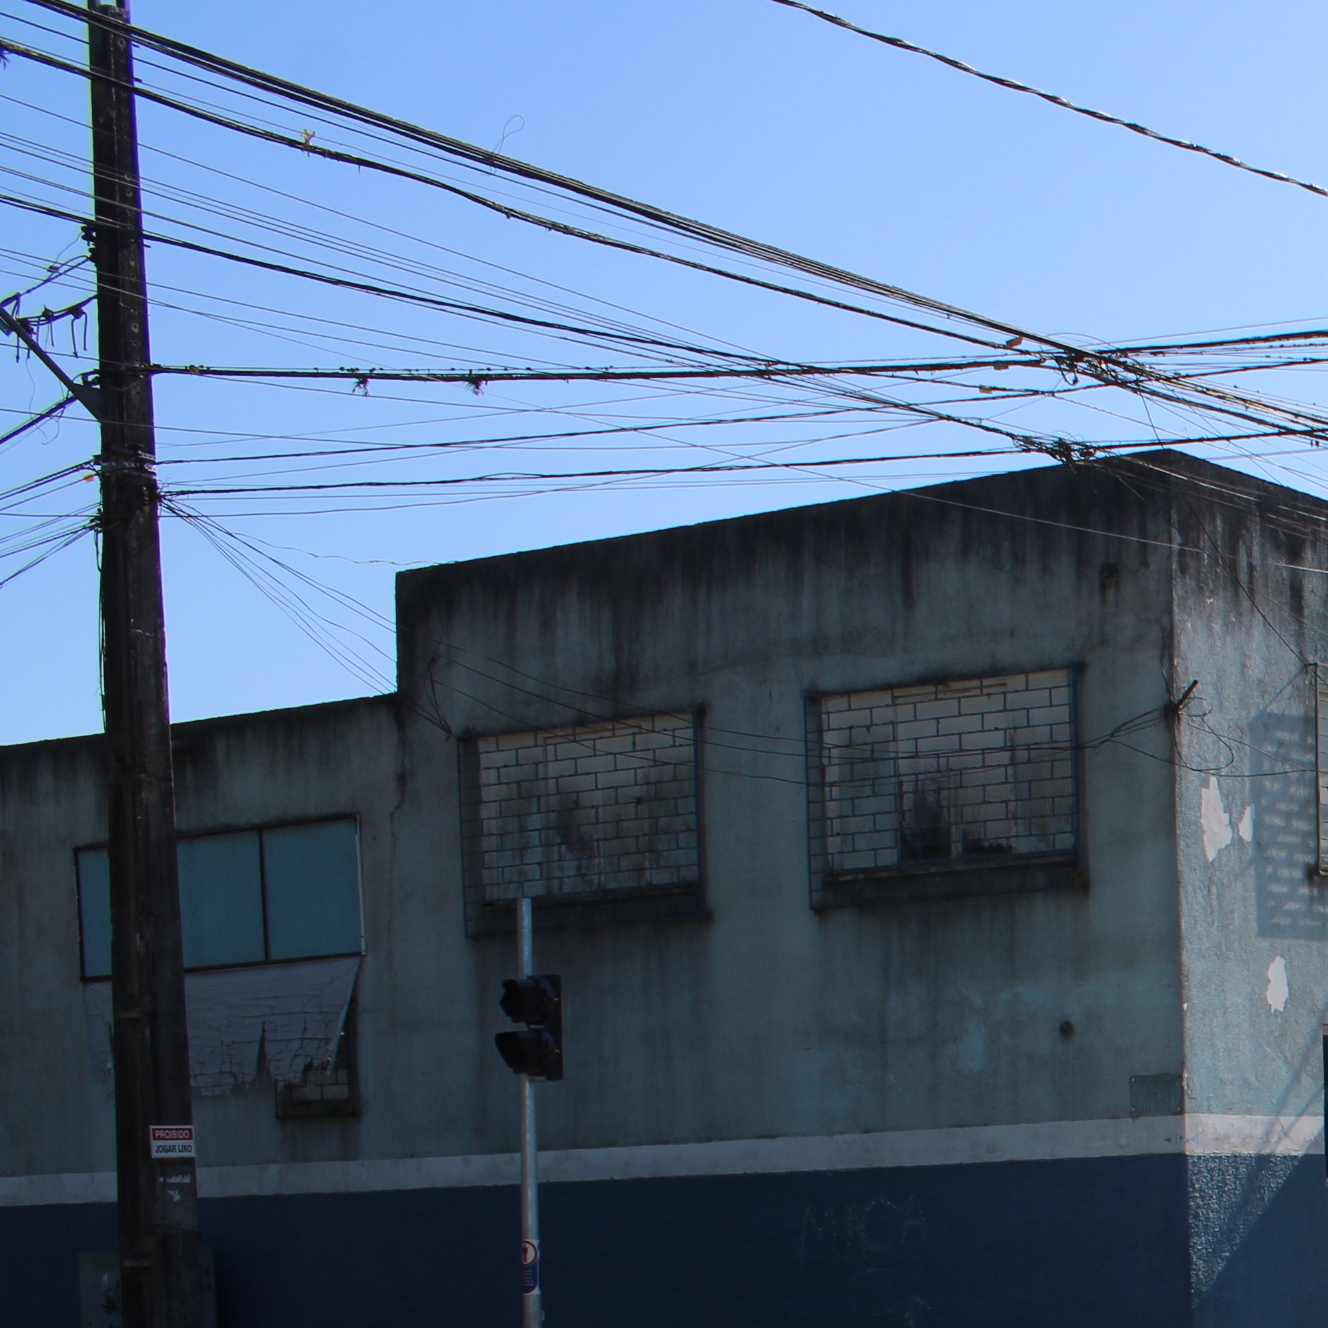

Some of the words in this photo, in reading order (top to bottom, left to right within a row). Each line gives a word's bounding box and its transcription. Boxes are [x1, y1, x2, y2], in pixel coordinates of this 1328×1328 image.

[155, 1130, 190, 1139] PROIBIDO
[155, 1145, 177, 1153] JOGAR
[178, 1145, 193, 1153] LIXO
